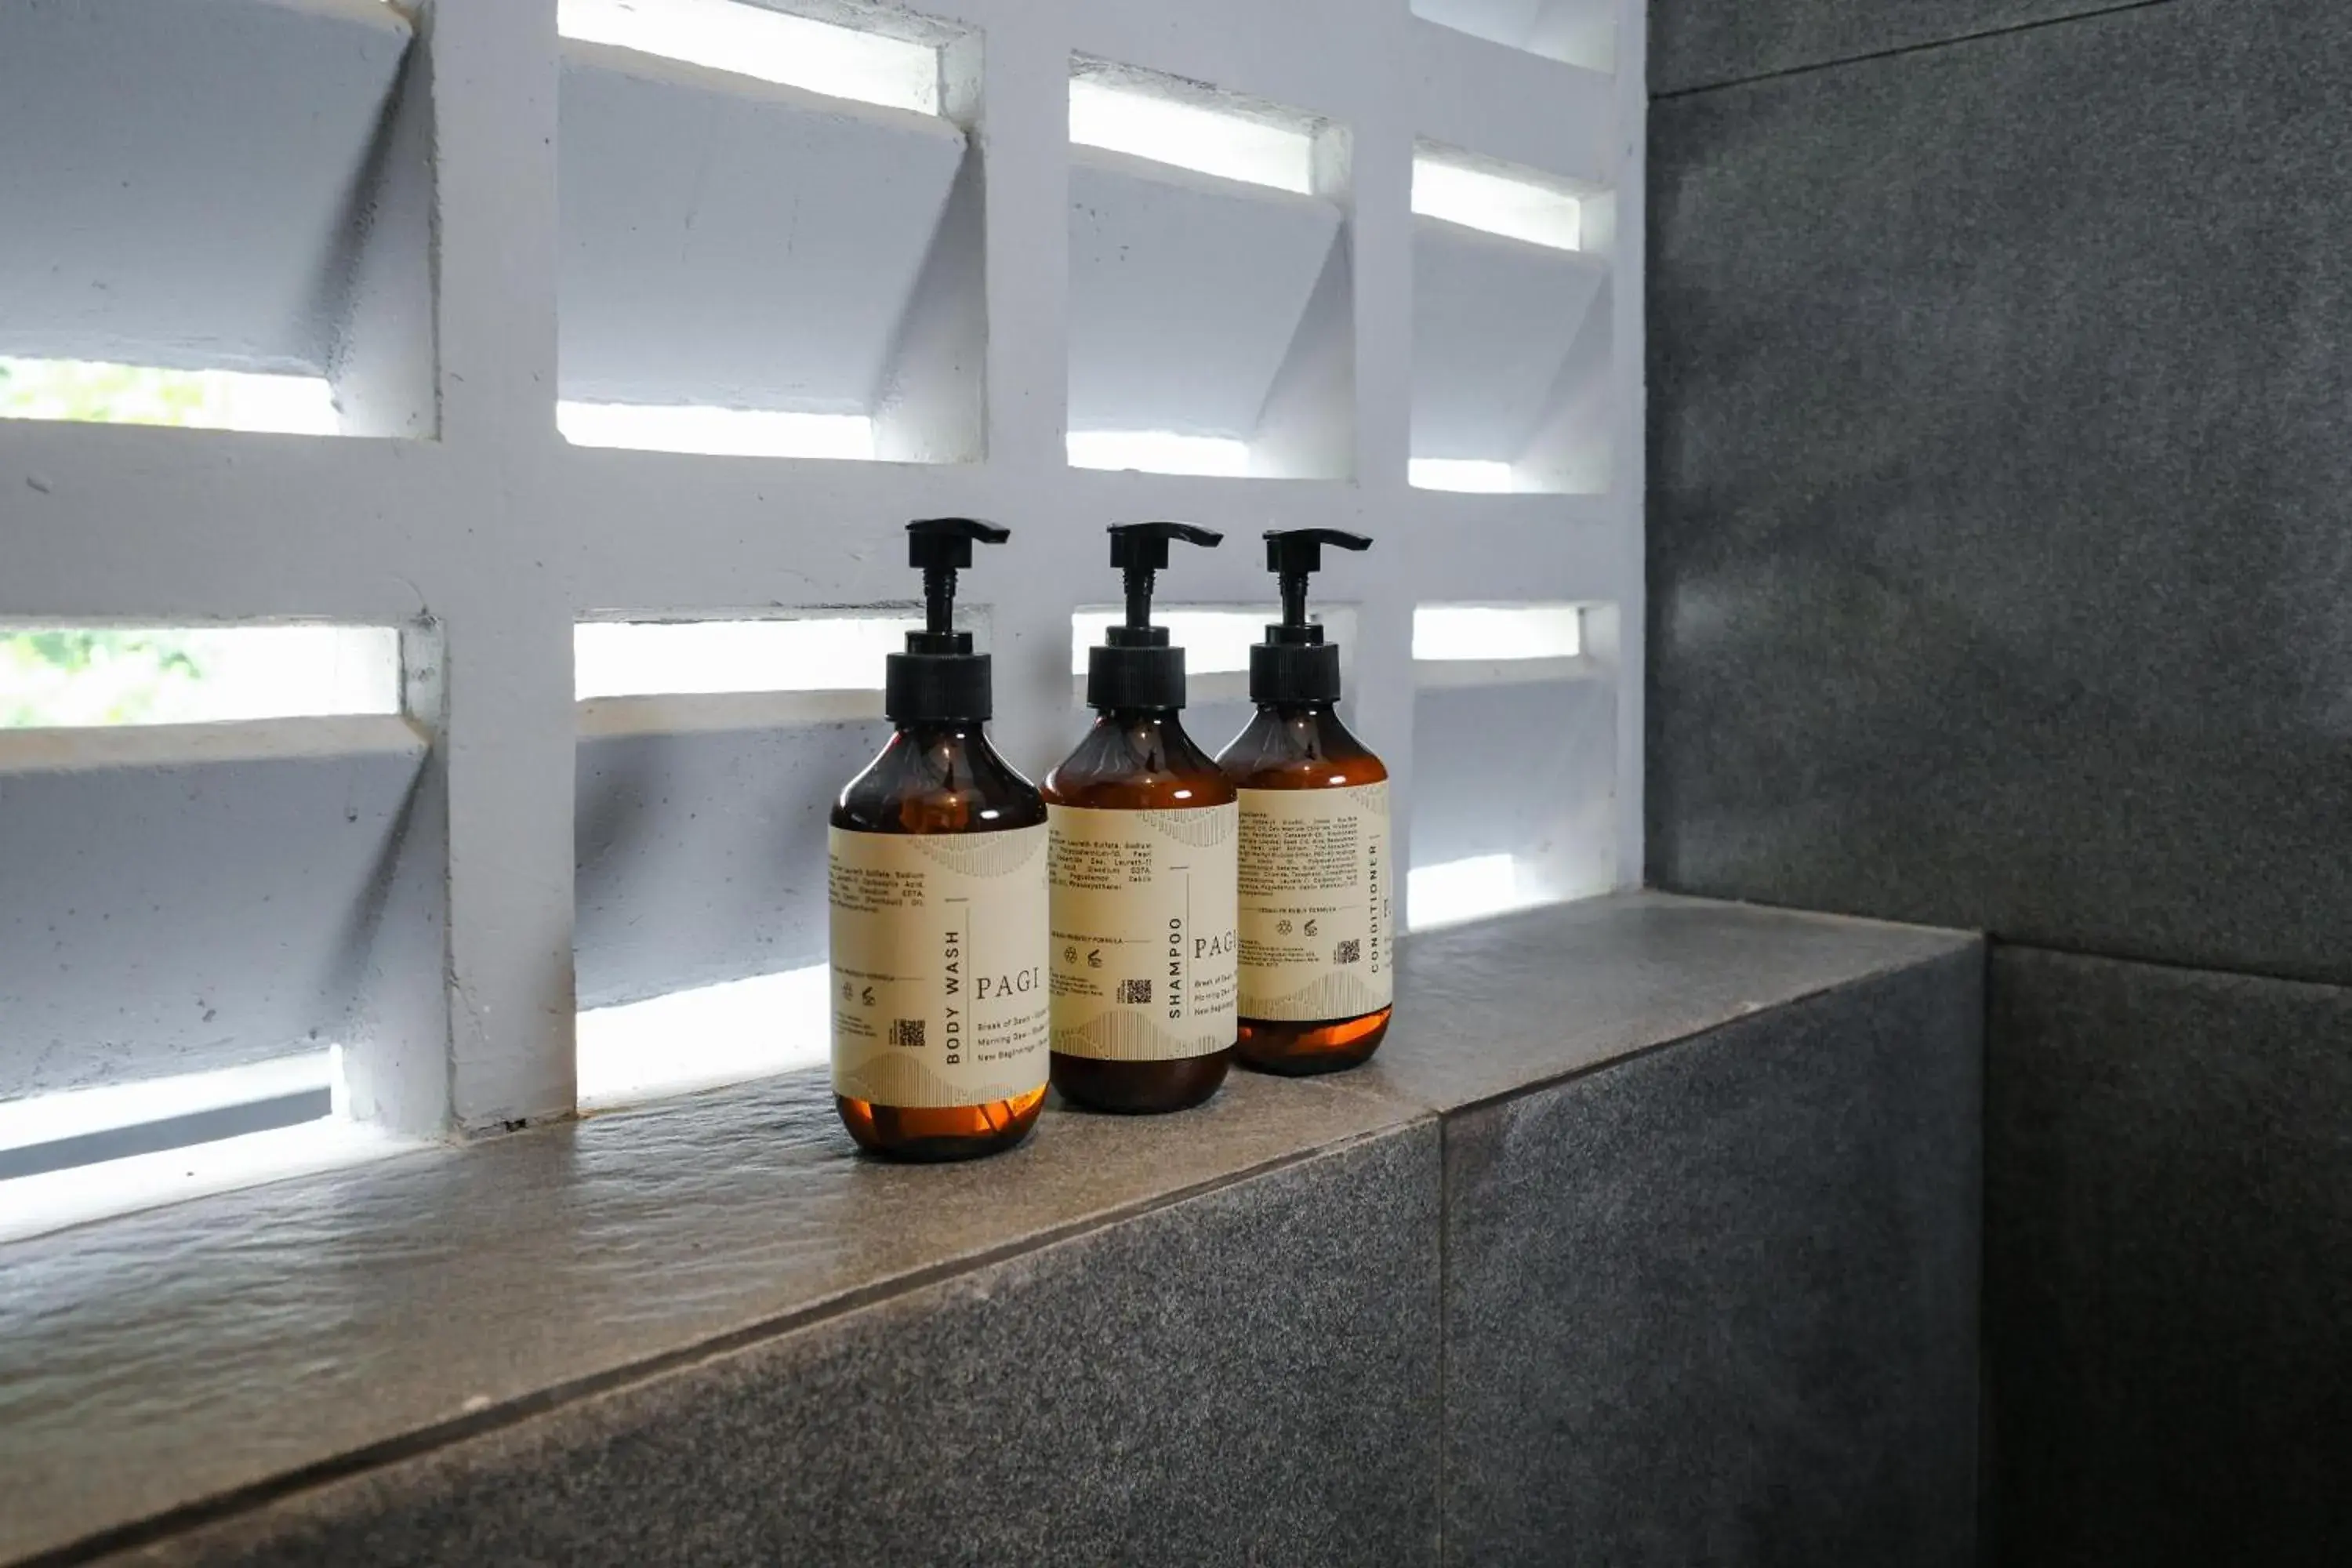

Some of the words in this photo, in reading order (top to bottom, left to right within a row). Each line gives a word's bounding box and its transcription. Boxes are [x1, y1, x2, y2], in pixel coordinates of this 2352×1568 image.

[1369, 846, 1379, 974] CONDITIONER
[945, 931, 959, 995] WASH
[976, 966, 1040, 1000] PAGI
[1169, 918, 1181, 1018] SHAMPOO
[946, 1007, 960, 1065] BODY
